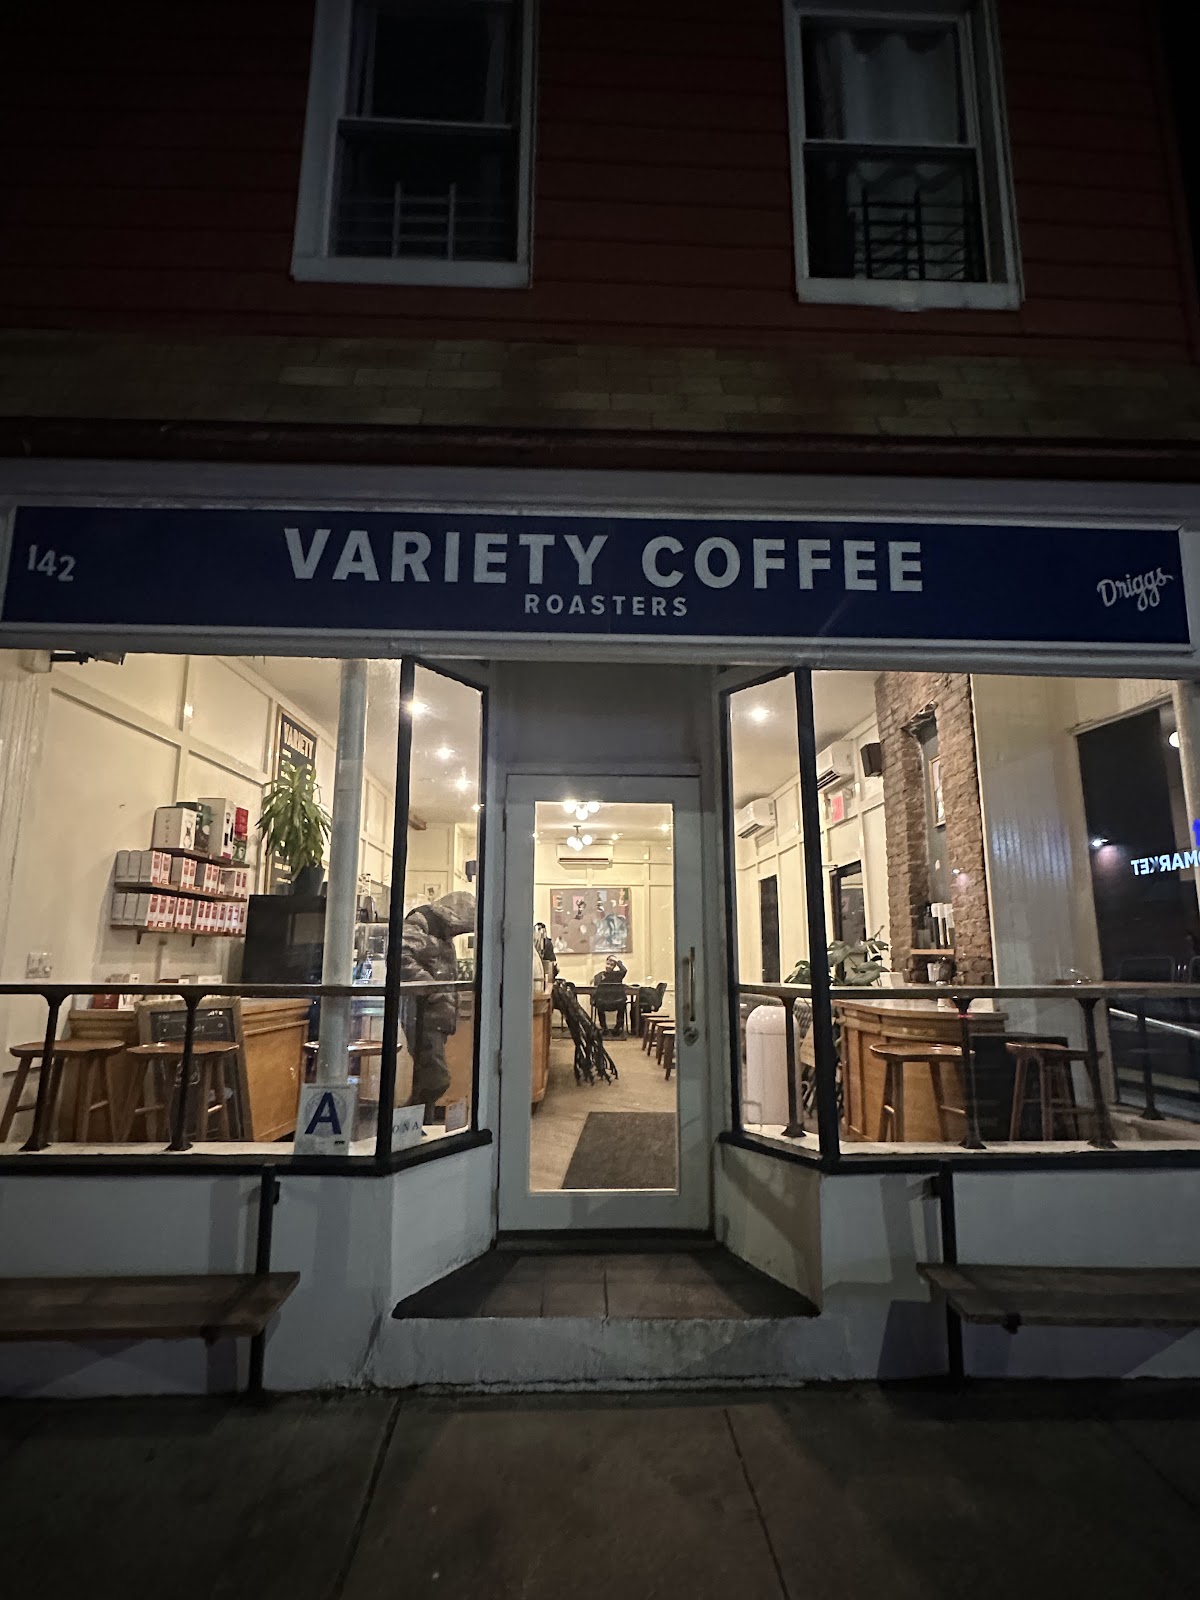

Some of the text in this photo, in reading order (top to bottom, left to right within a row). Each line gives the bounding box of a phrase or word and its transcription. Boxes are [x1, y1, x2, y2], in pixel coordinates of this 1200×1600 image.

[28, 544, 76, 582] 142
[284, 527, 923, 592] VARIETY COFFEE
[524, 593, 688, 617] ROASTERS
[1096, 567, 1174, 612] Driggs
[283, 721, 315, 760] VARIETY
[304, 1092, 342, 1135] A
